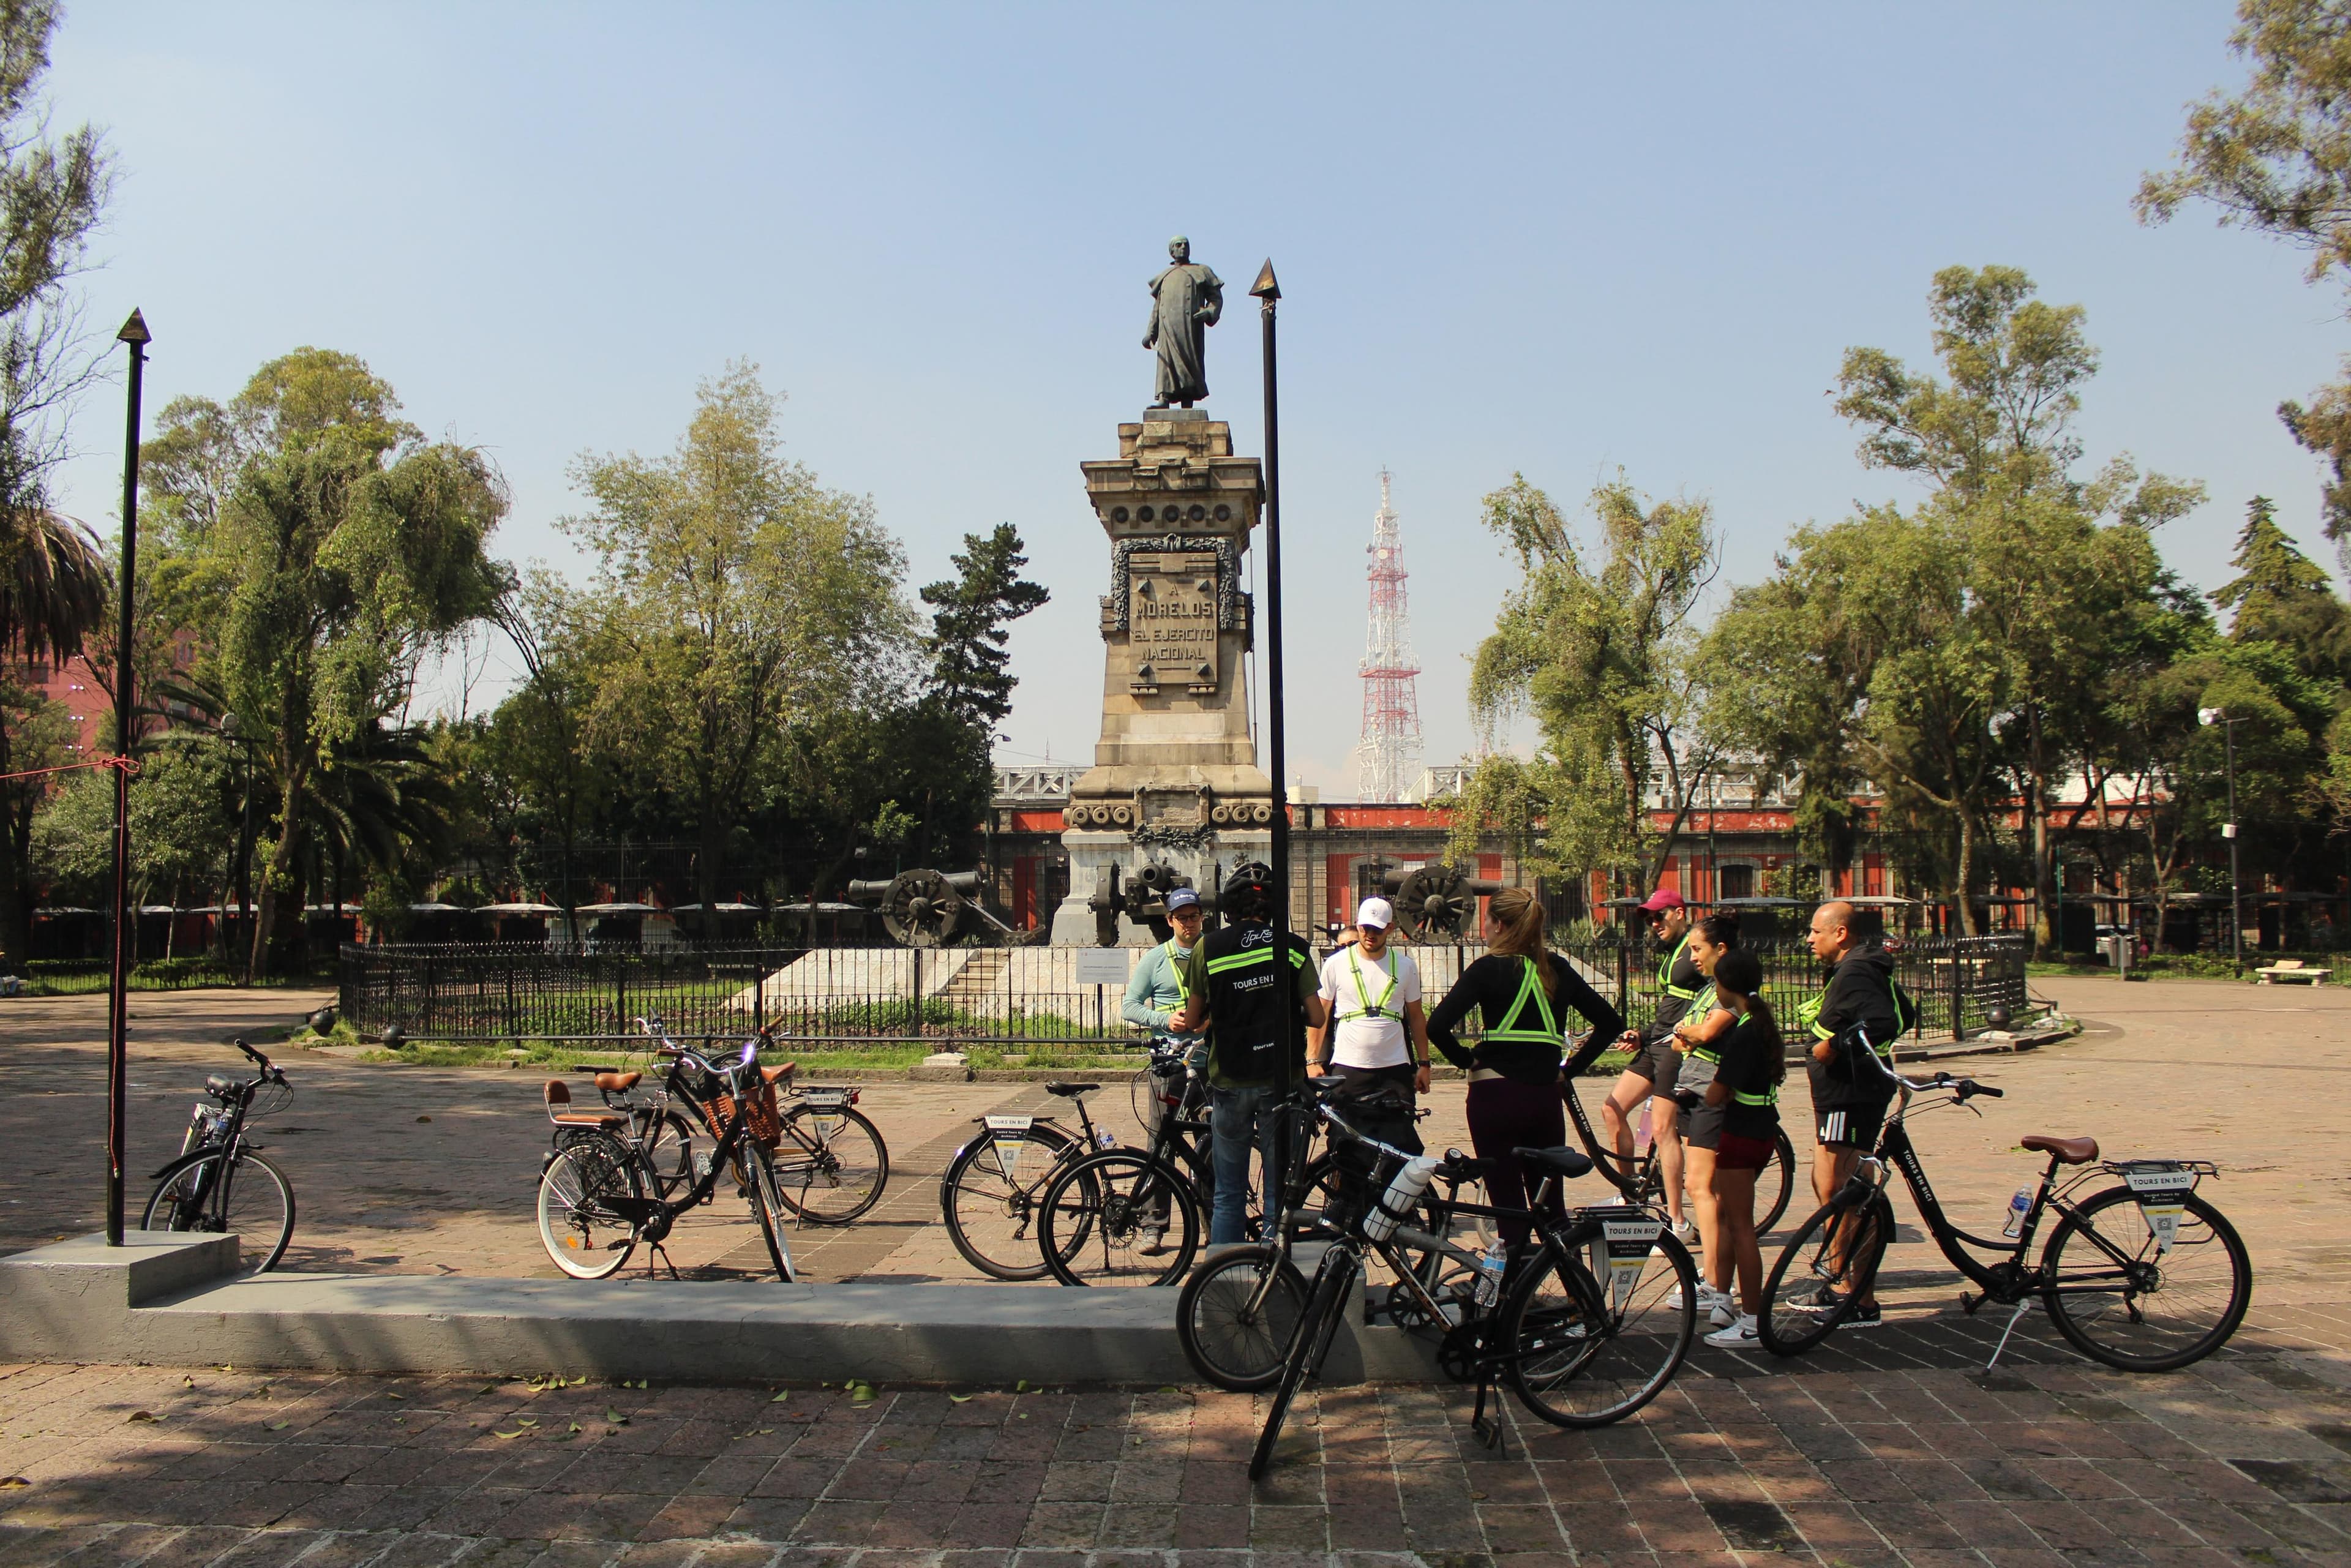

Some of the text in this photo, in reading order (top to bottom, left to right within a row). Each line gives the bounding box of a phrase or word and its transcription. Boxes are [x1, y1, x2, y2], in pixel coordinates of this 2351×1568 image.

[1169, 583, 1178, 596] A
[1136, 601, 1213, 618] MORELOS
[1134, 628, 1214, 642] EL EJERCITO
[1142, 648, 1205, 661] NACIONAL
[1232, 978, 1258, 989] TOURS
[1259, 975, 1269, 984] EN
[1572, 1094, 1581, 1112] TOURS
[1903, 1150, 1933, 1201] TOURS EN BICI
